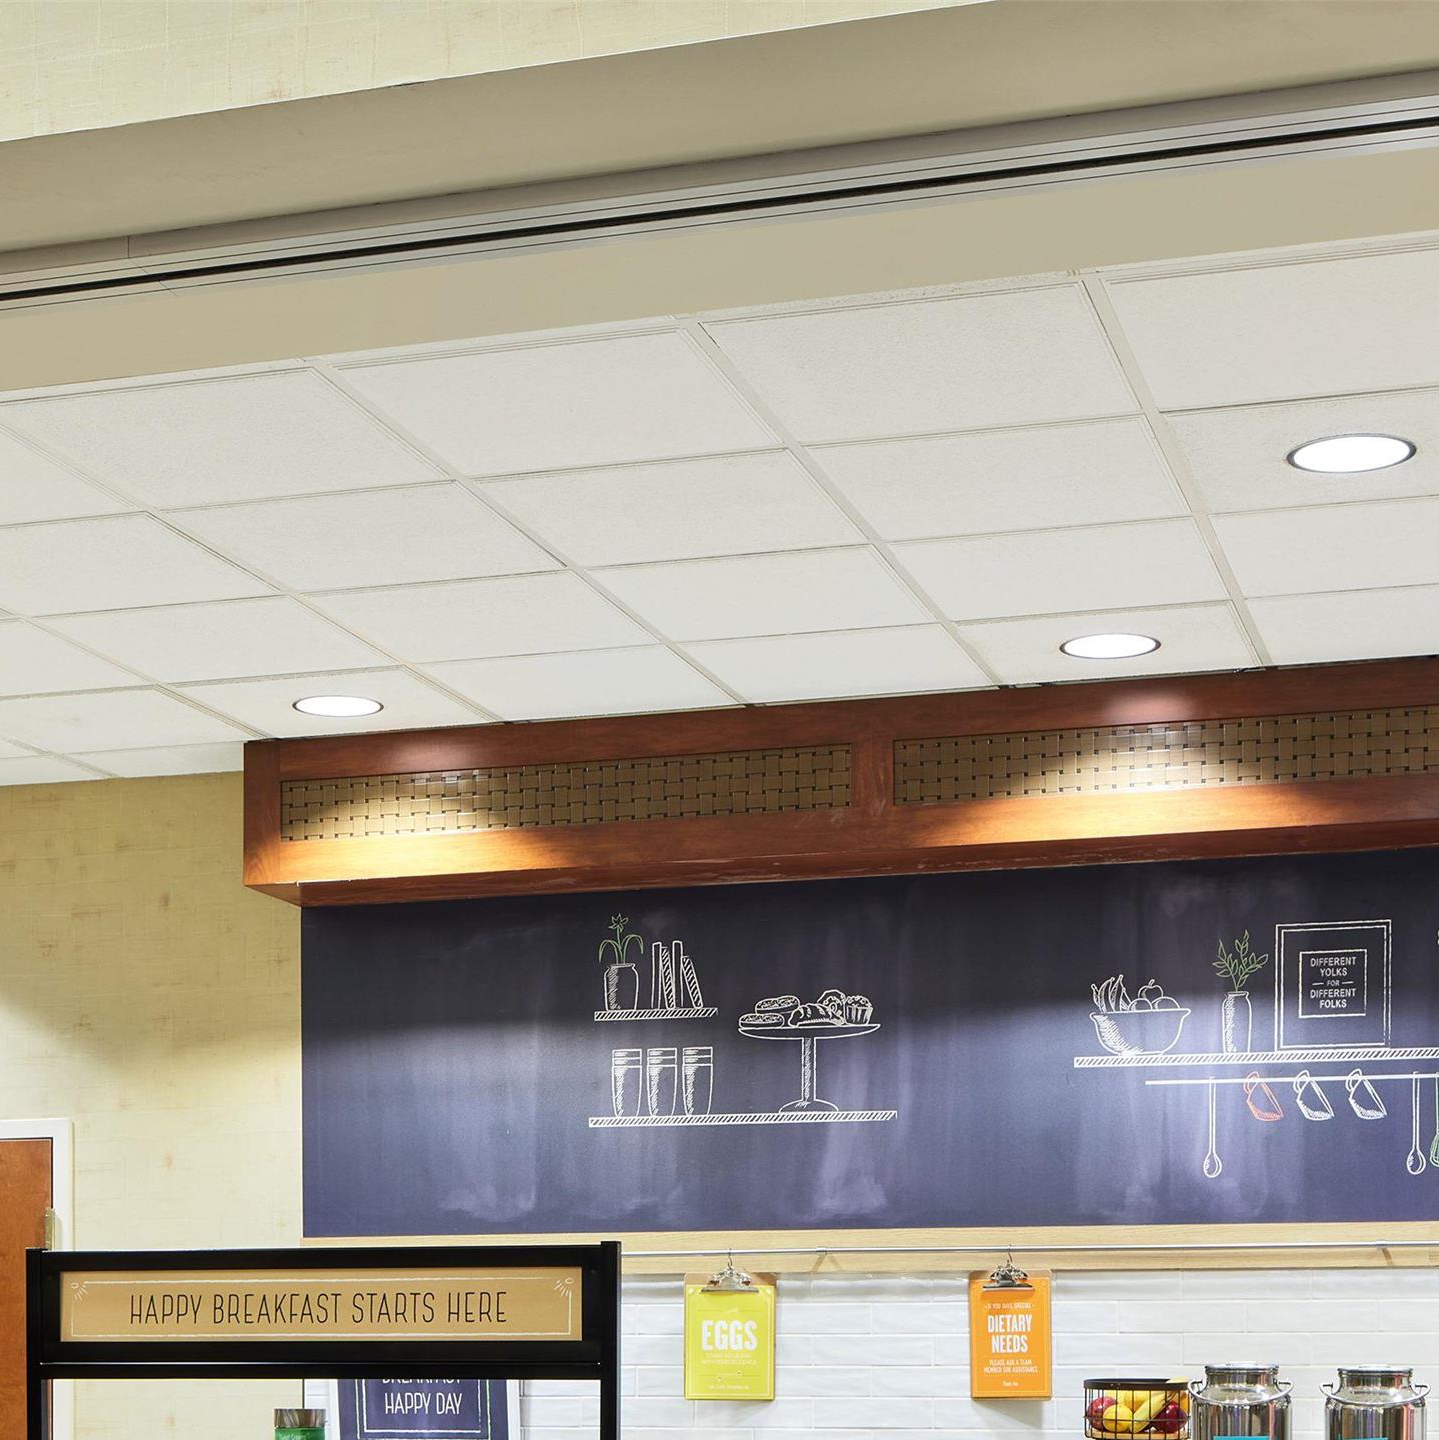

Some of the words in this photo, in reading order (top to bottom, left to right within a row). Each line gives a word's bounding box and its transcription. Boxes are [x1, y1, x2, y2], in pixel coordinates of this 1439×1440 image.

[1311, 956, 1357, 967] DIFFERENT
[1320, 968, 1347, 977] YOLKS
[1310, 988, 1357, 999] DIFFERENT
[1319, 999, 1347, 1008] FOLKS
[130, 1294, 202, 1324] HAPPY
[213, 1293, 342, 1324] BREAKFAST
[352, 1292, 435, 1323] STARTS
[448, 1291, 507, 1323] HERE
[987, 1314, 1032, 1333] DIETARY
[702, 1320, 757, 1351] EGGS
[992, 1335, 1028, 1353] NEEDS
[384, 1392, 431, 1415] HAPPY
[436, 1392, 462, 1415] DAY
